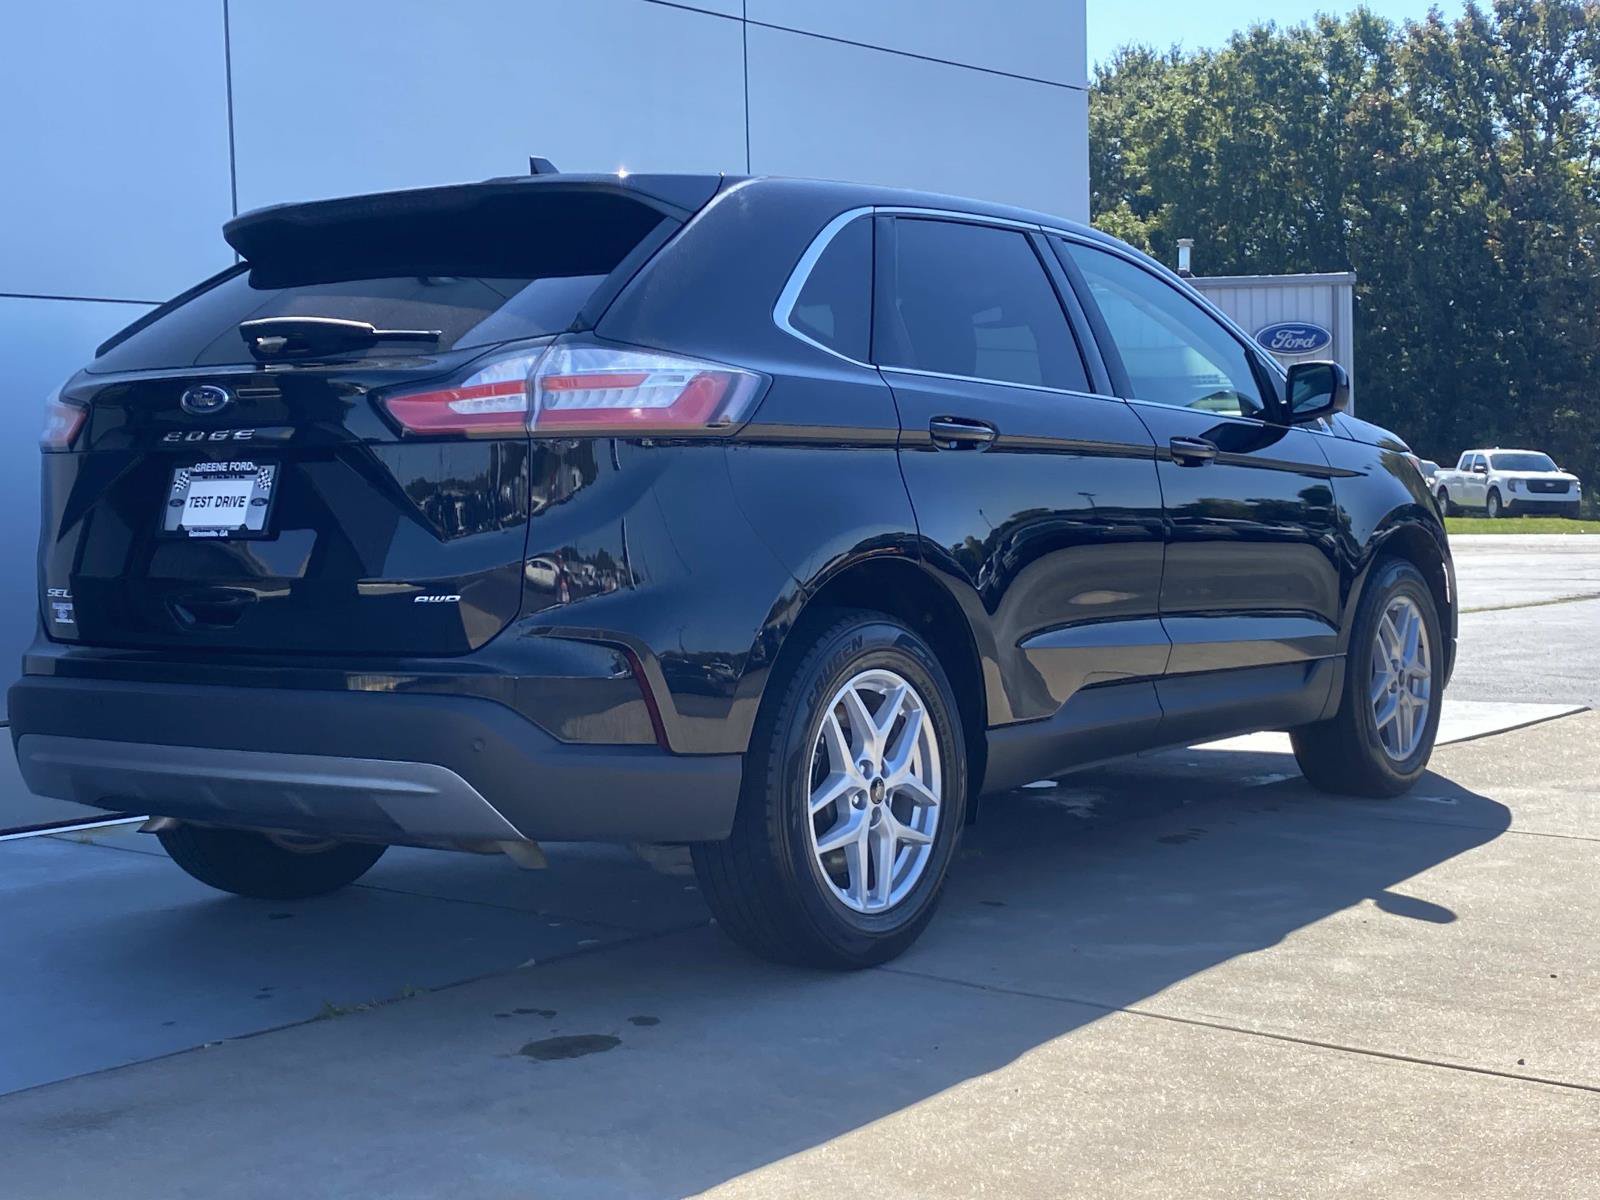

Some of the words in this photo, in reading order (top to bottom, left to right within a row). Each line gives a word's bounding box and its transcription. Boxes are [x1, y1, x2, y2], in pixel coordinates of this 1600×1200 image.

[1271, 329, 1316, 348] Ford
[163, 428, 256, 442] EDGE
[195, 462, 228, 472] GREENE
[229, 461, 254, 471] FORD
[189, 496, 214, 508] TEST
[214, 495, 247, 508] DRIVE
[47, 588, 73, 598] SEL
[414, 595, 461, 603] AWD
